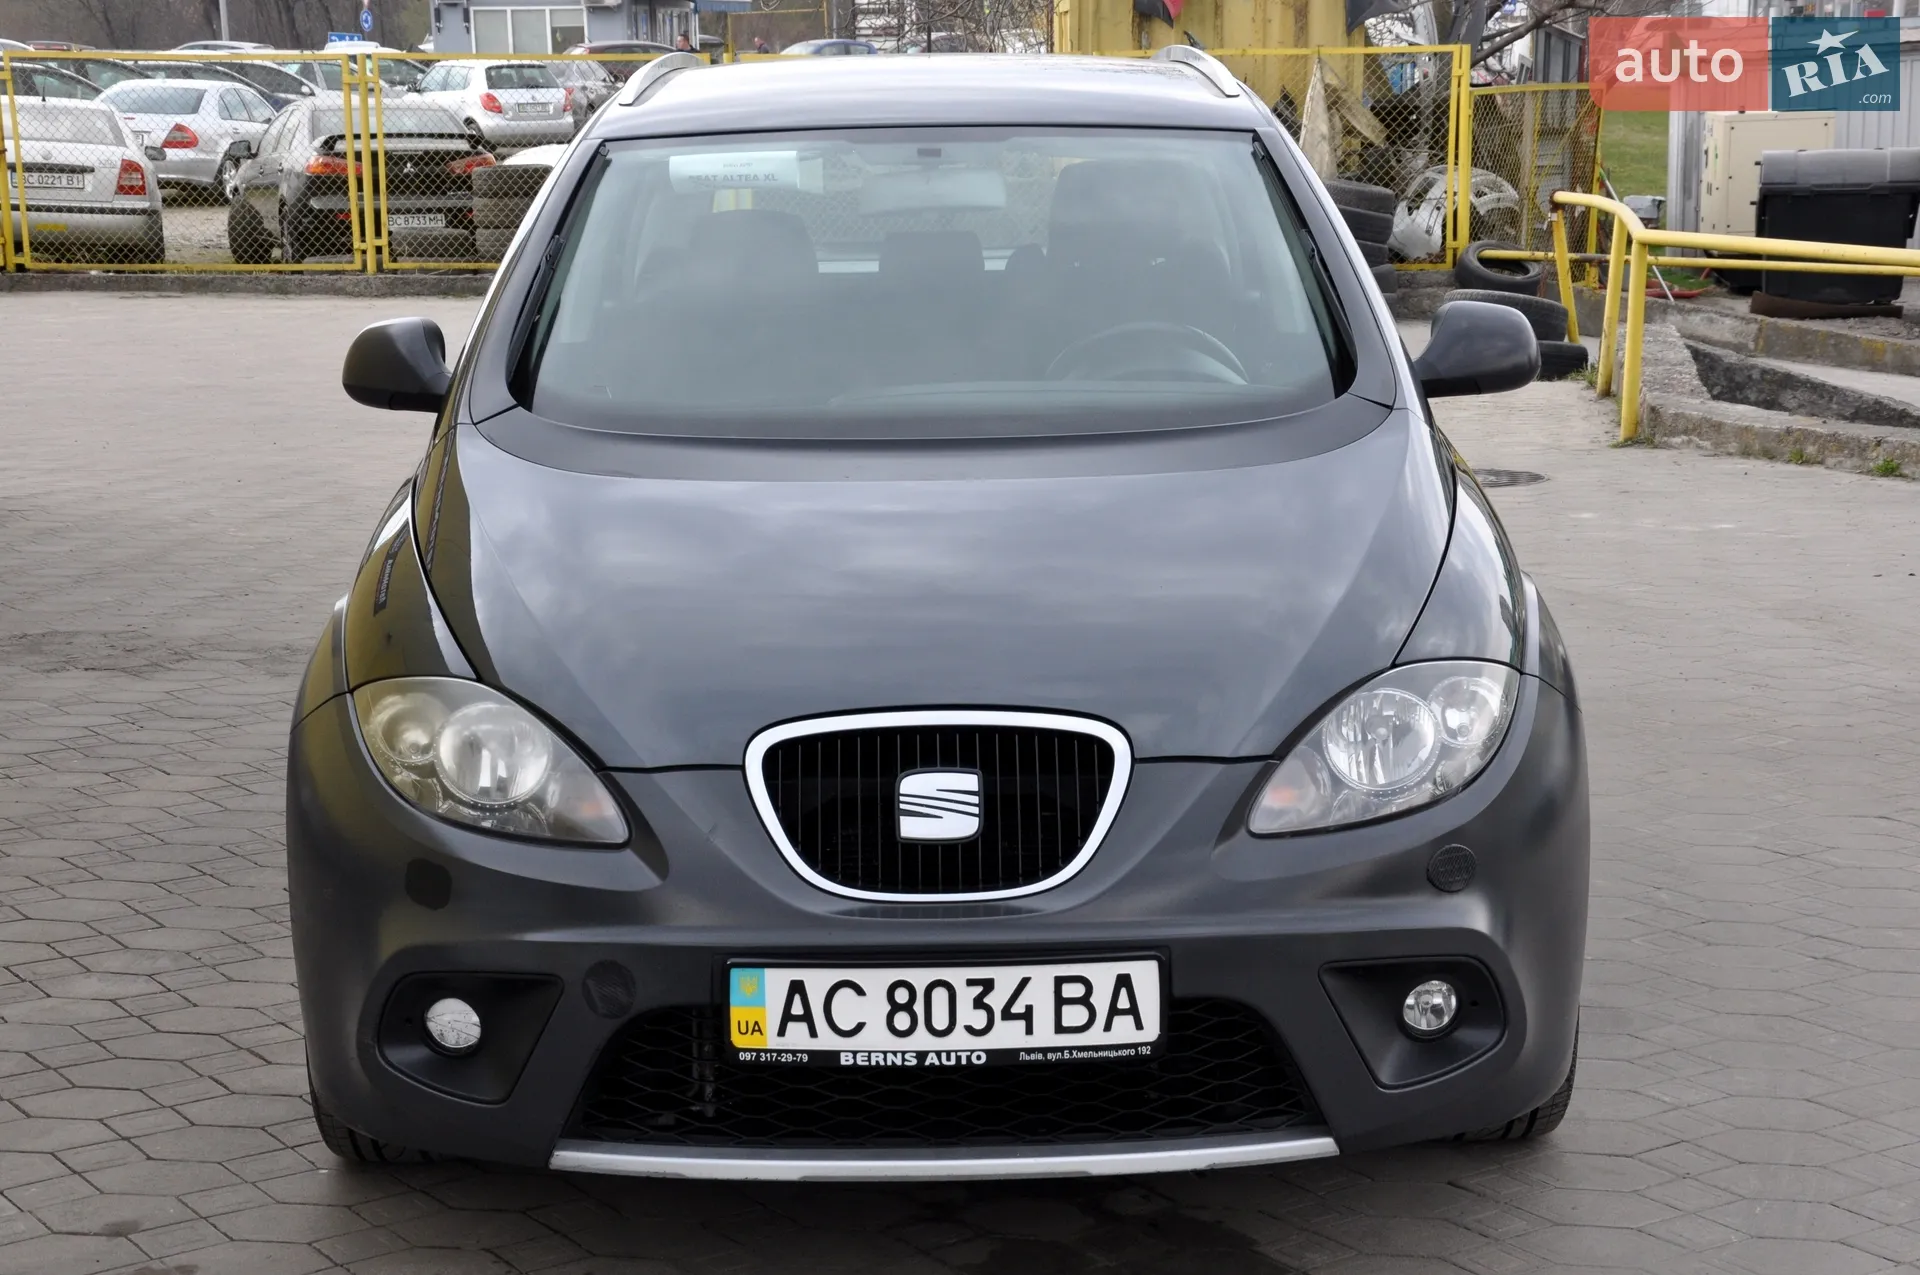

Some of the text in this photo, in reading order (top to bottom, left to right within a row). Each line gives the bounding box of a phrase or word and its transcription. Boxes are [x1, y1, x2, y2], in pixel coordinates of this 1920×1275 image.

[37, 174, 62, 186] 0221
[763, 172, 779, 182] XL
[403, 215, 427, 226] 8733
[776, 972, 1145, 1039] AC 8034 BA
[737, 1019, 764, 1037] UA
[738, 1051, 809, 1063] 097 317-29-79
[839, 1050, 987, 1066] BERNS AUTO
[1019, 1050, 1045, 1062] Львів,
[1137, 1045, 1151, 1056] 192
